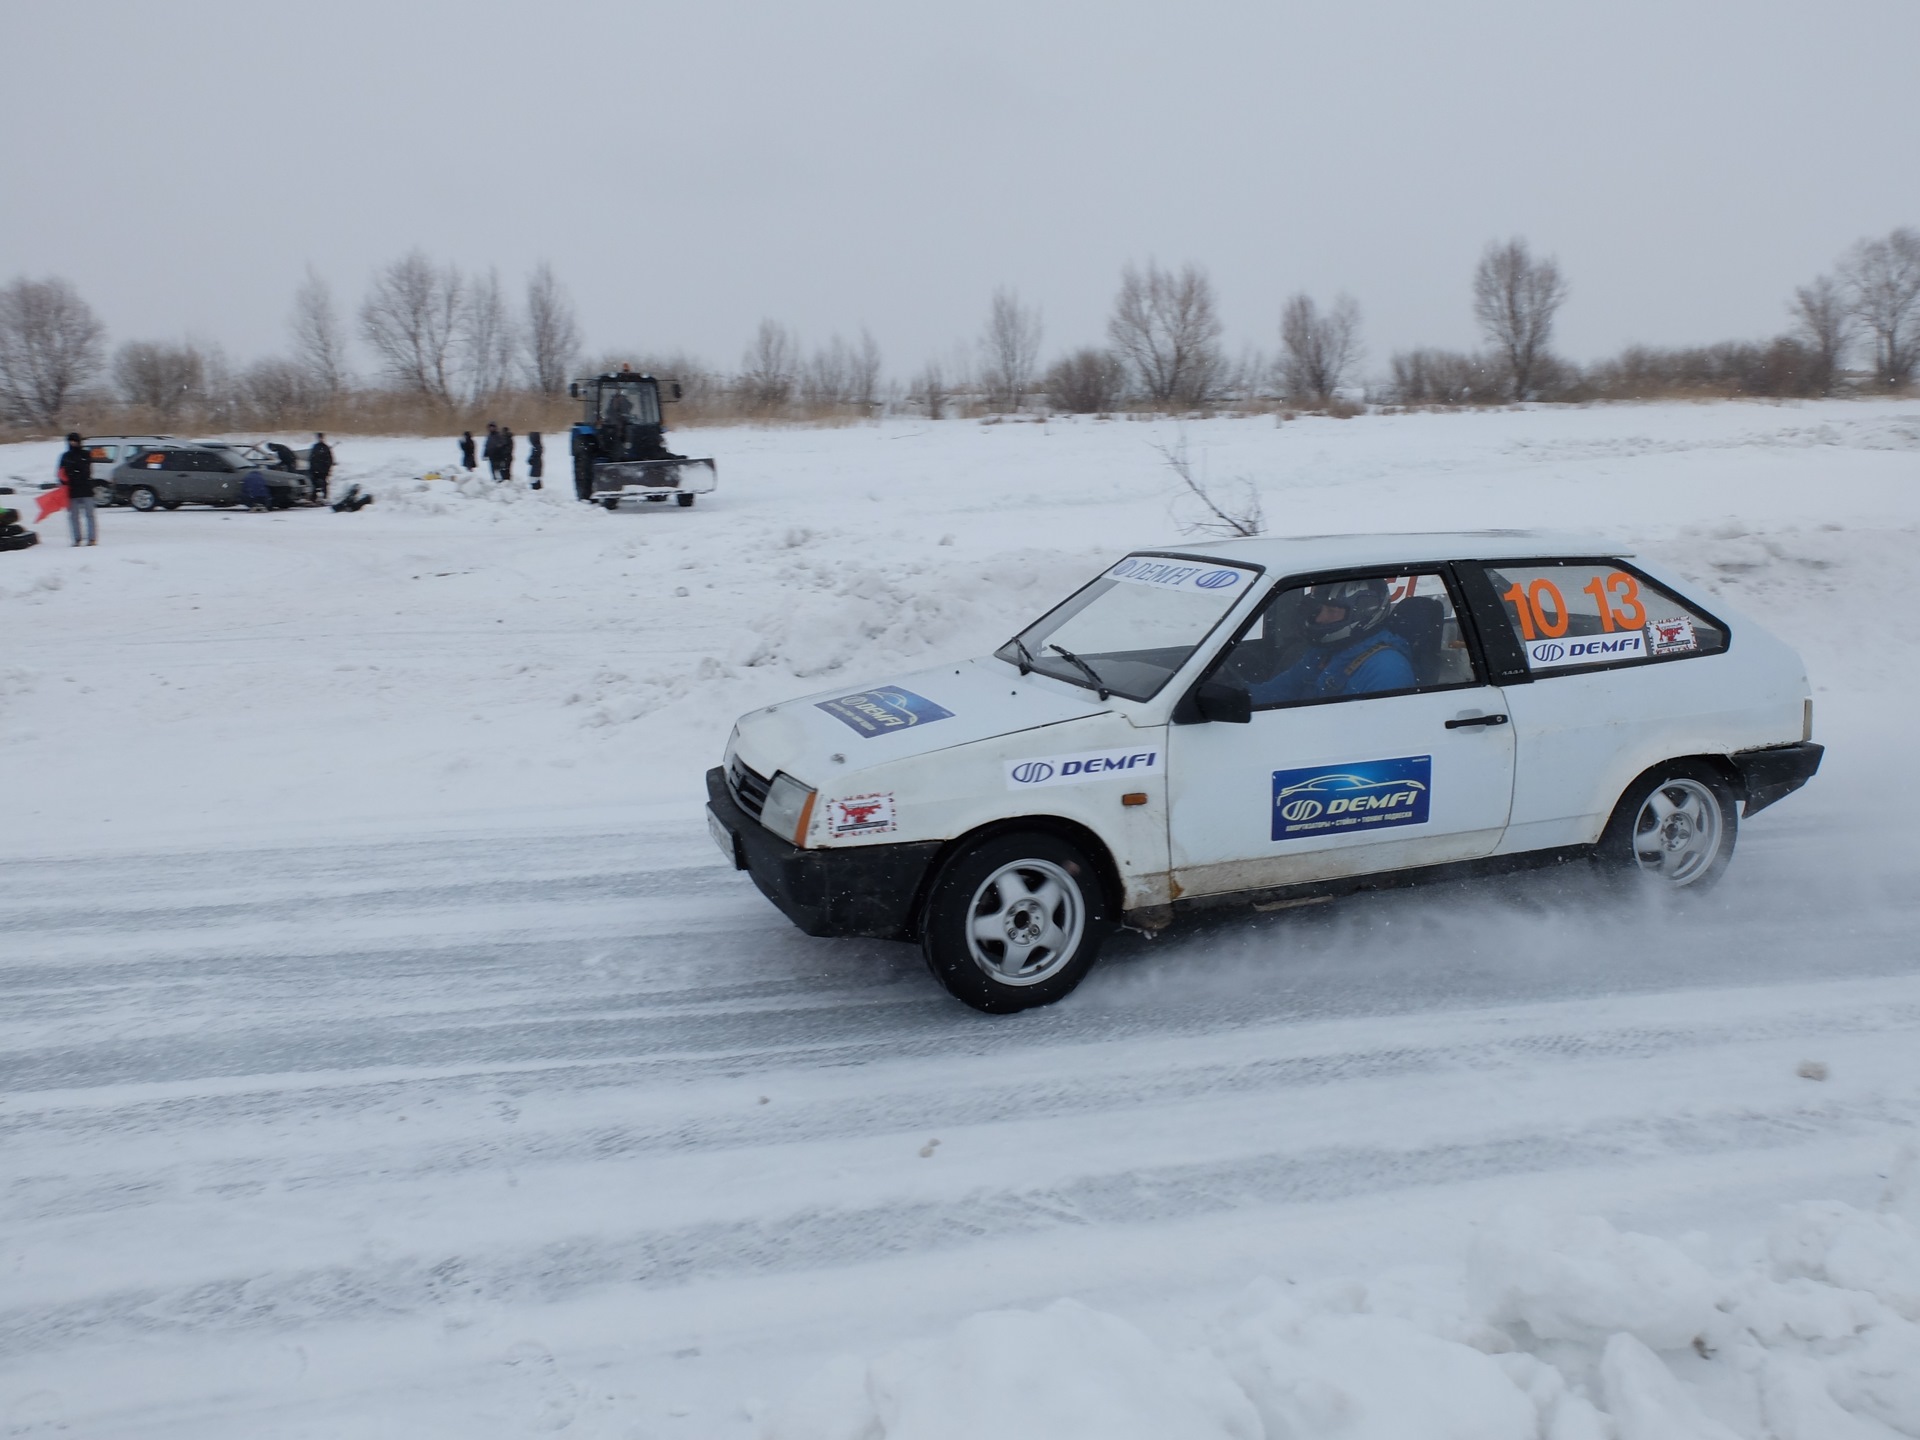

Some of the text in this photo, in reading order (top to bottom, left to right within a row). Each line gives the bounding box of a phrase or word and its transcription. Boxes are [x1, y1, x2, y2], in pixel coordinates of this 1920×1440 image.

[1127, 563, 1201, 585] DEMFI
[1503, 571, 1647, 640] 10 13
[1569, 638, 1640, 656] DEMFI
[855, 702, 905, 727] DEMFI
[1061, 753, 1157, 776] DEMFI
[1326, 791, 1418, 815] DEMFI
